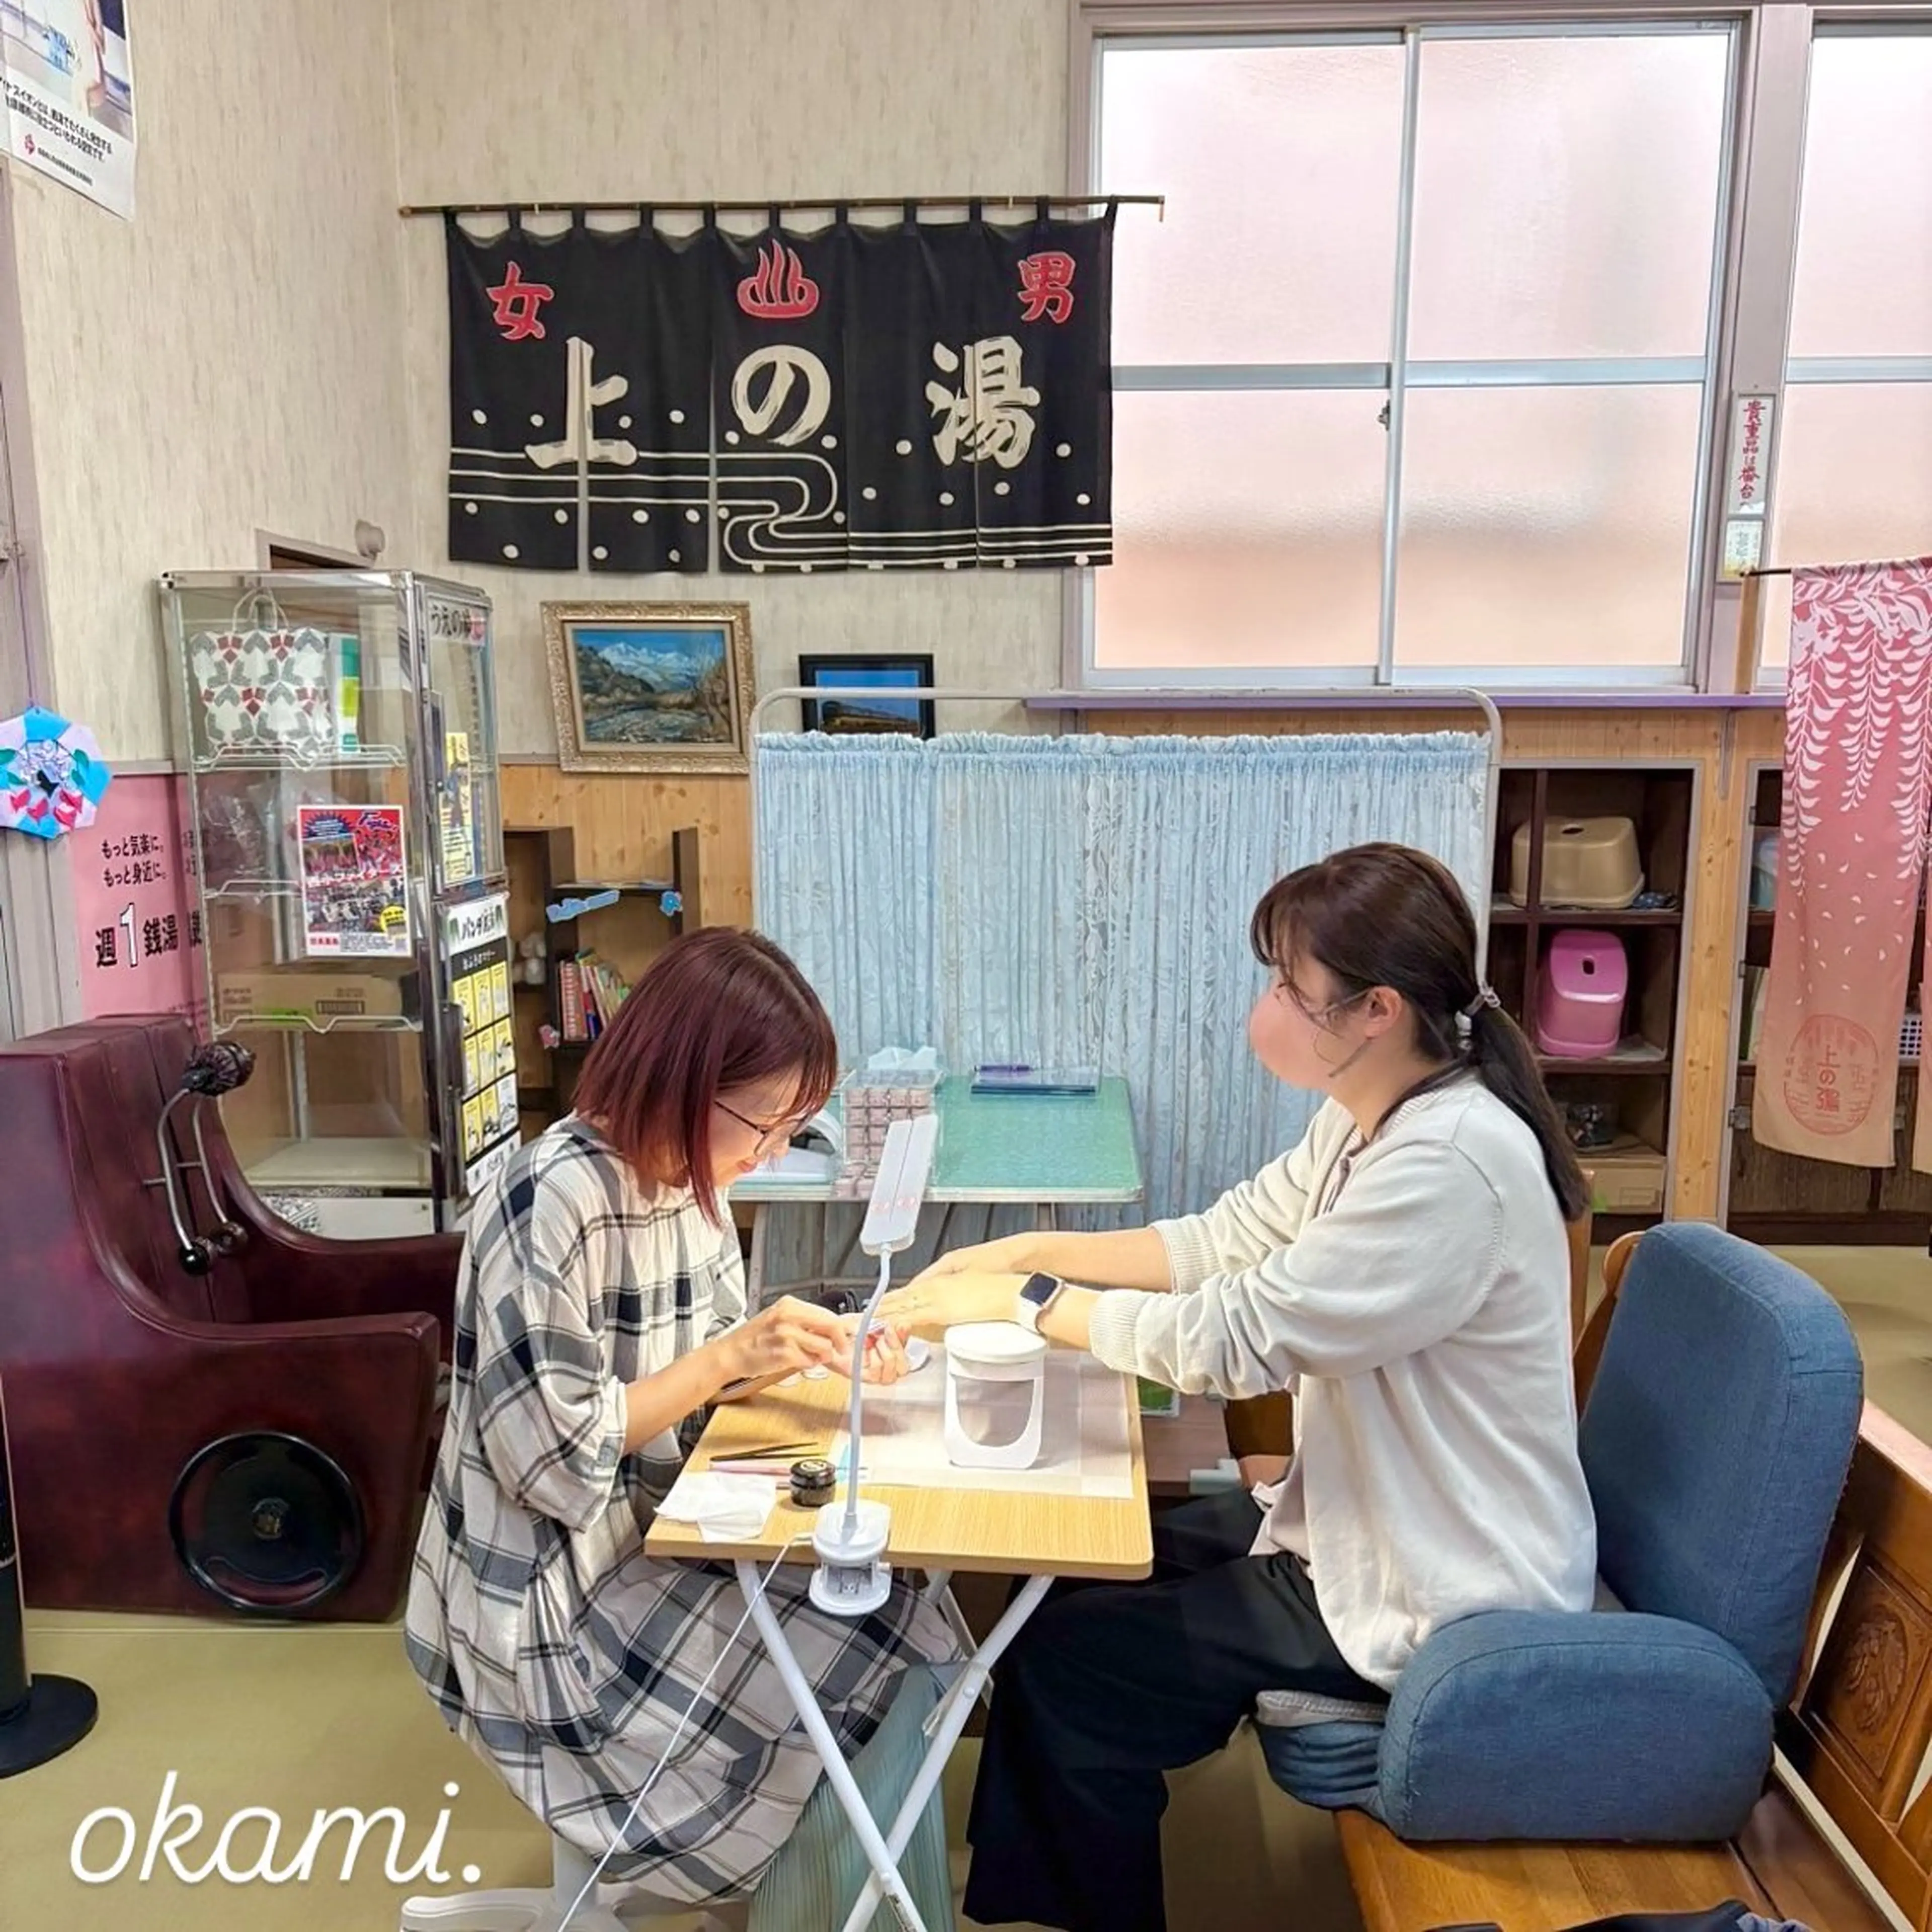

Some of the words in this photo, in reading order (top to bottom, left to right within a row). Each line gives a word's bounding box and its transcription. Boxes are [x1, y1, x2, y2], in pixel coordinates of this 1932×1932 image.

[486, 261, 554, 341] 女
[1017, 251, 1077, 325] 男
[524, 335, 1040, 469] 上の湯
